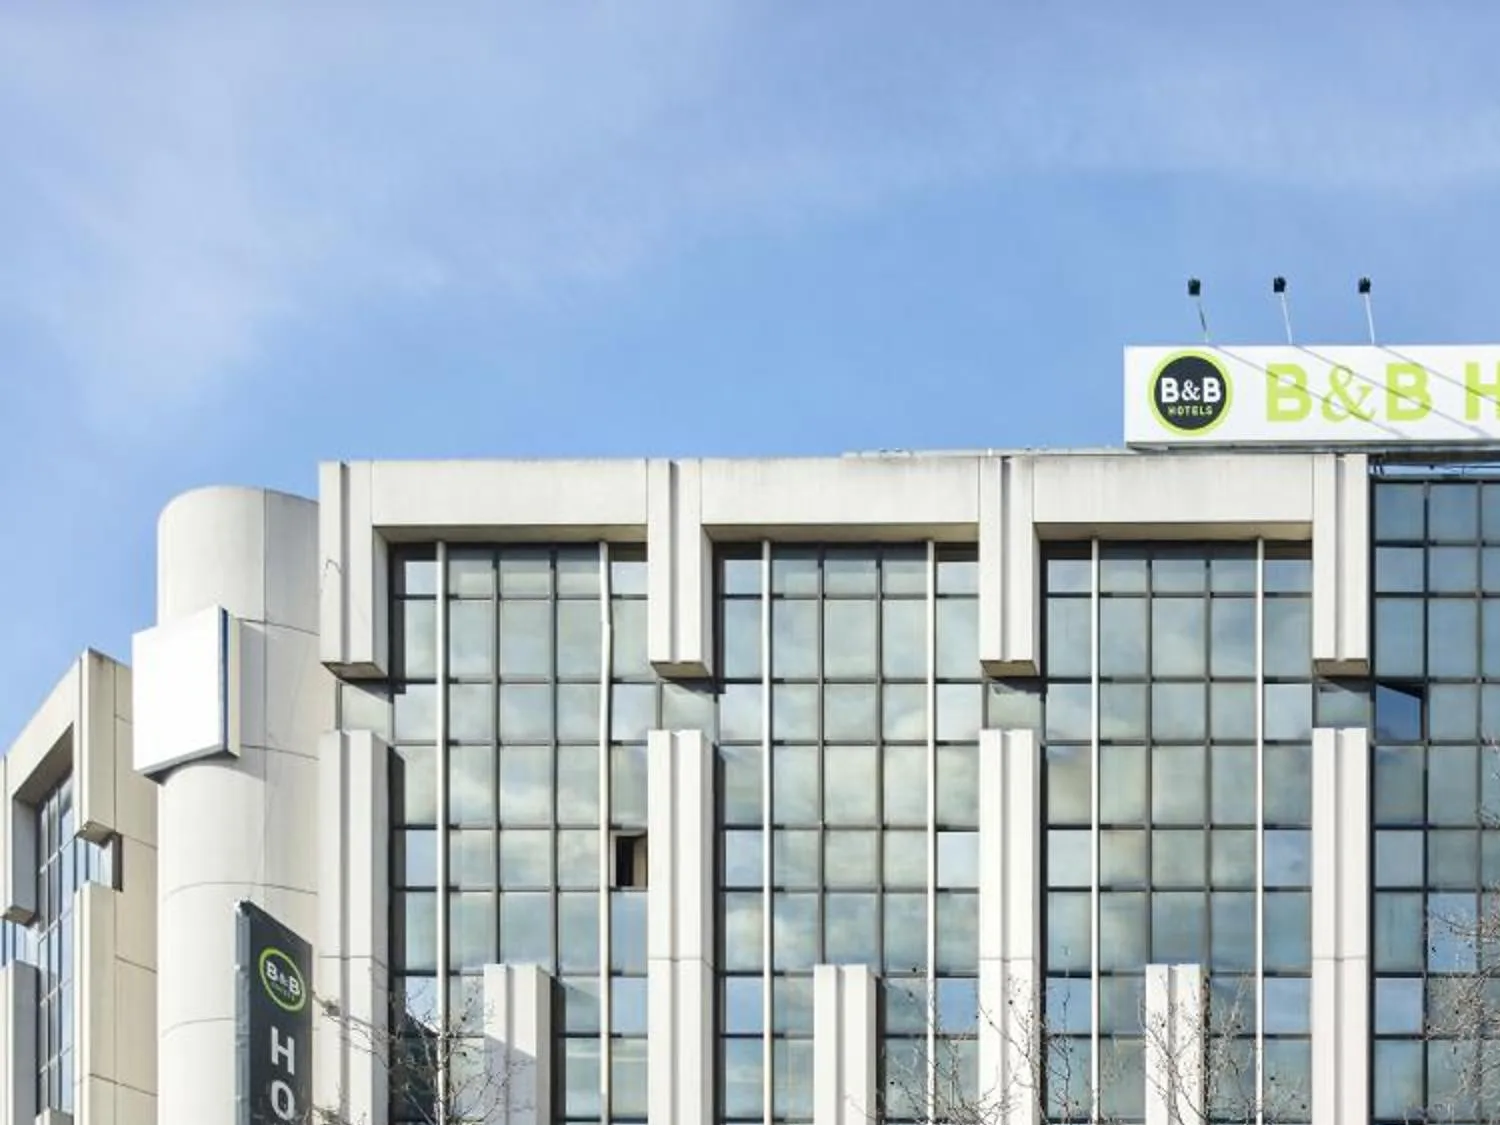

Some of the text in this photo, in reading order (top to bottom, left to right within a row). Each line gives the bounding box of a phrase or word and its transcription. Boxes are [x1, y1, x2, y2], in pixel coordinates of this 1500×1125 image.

[1161, 377, 1221, 402] B&B
[1266, 361, 1432, 423] B&B
[1167, 405, 1213, 416] HOTELS
[266, 960, 300, 995] B&B
